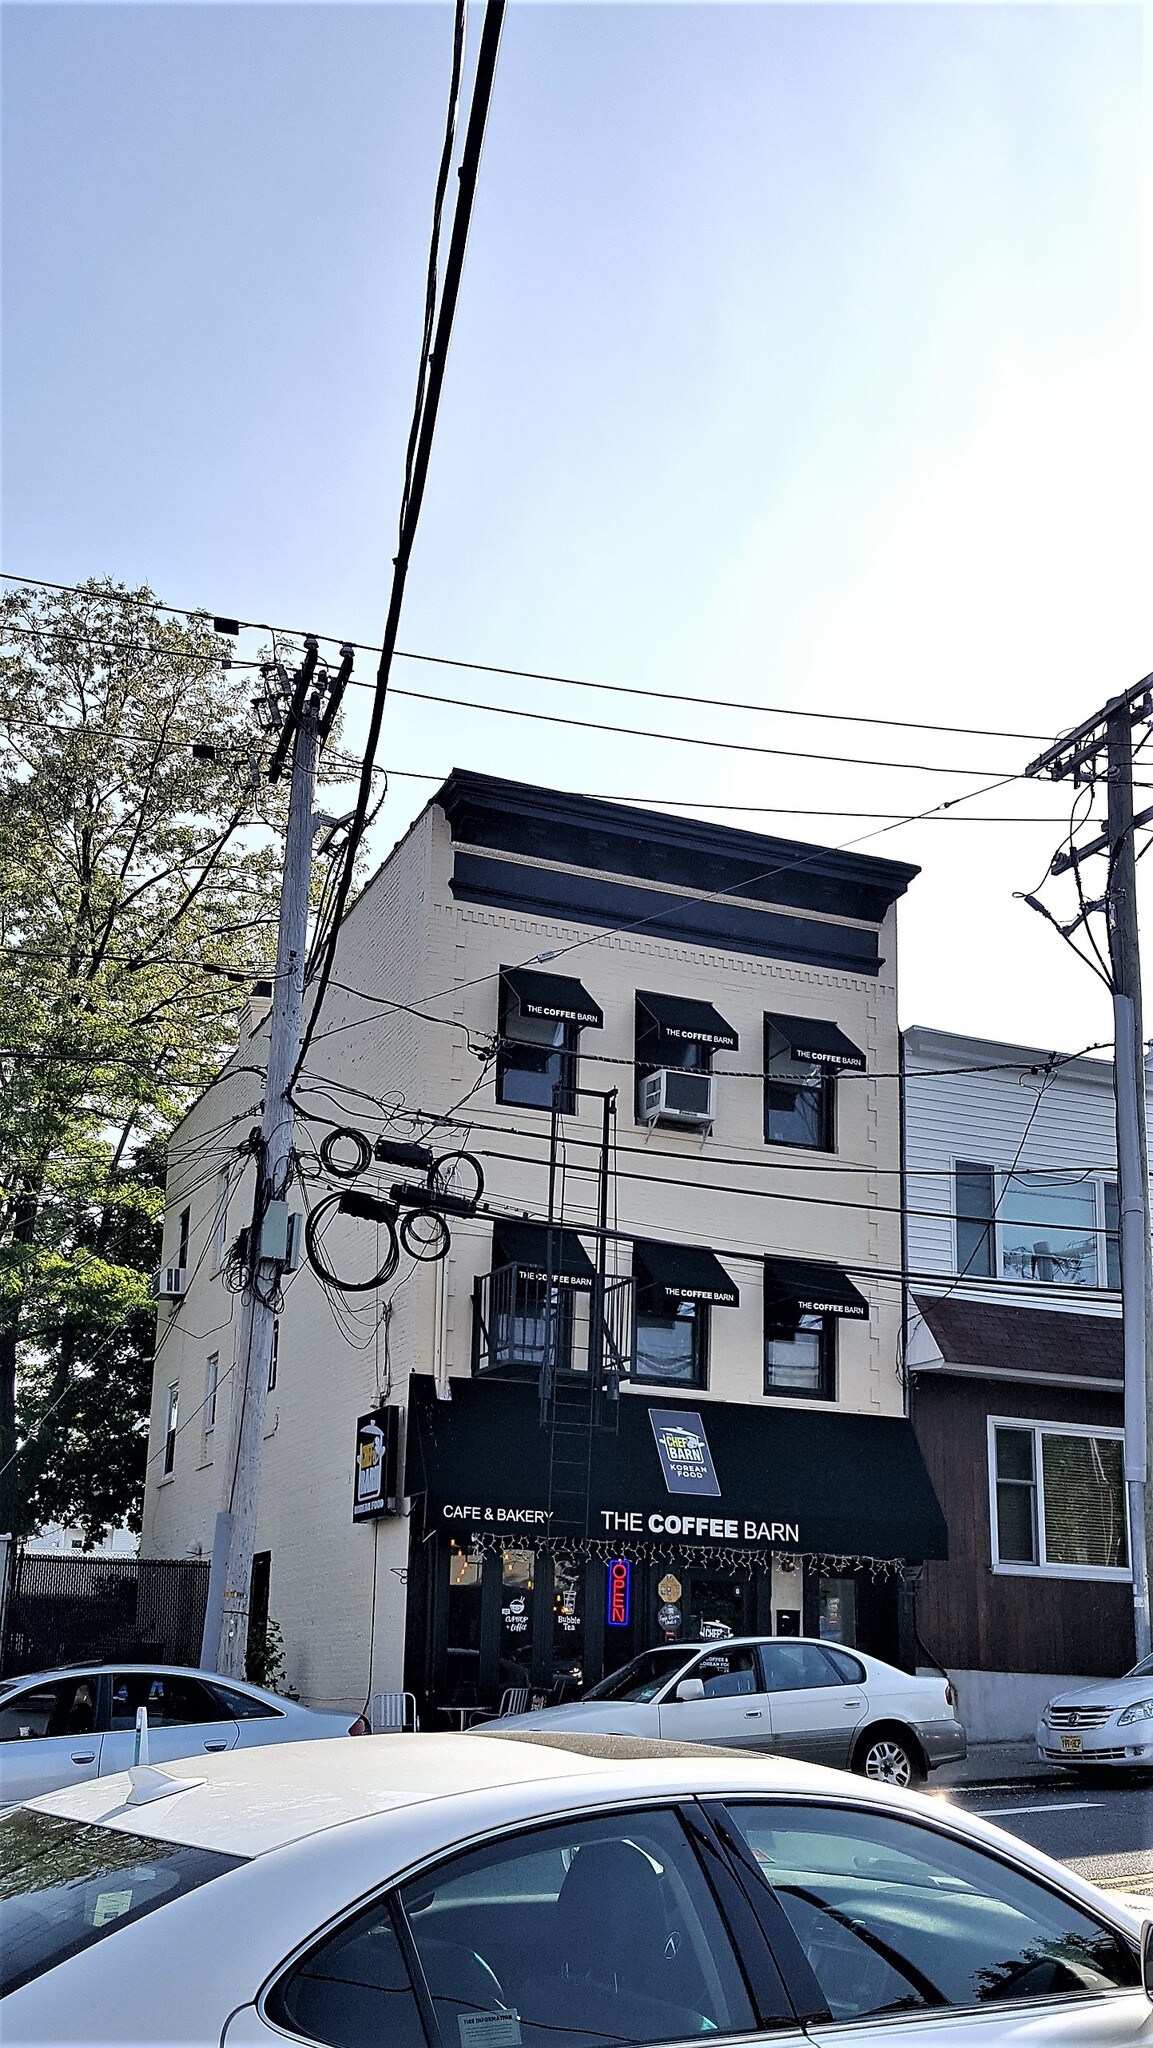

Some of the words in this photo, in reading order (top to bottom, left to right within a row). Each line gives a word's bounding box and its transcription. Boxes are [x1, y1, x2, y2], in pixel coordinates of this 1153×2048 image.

[527, 1004, 543, 1014] THE
[543, 1007, 576, 1020] COFFEE
[577, 1012, 598, 1023] BARN
[665, 1027, 681, 1037] THE
[681, 1030, 713, 1042] COFFEE
[713, 1035, 734, 1045] BARN
[796, 1049, 811, 1059] THE
[811, 1052, 841, 1064] COFFEE
[842, 1056, 862, 1066] BARN
[518, 1270, 535, 1280] THE
[535, 1273, 570, 1284] COFEE
[570, 1276, 592, 1286] BARN
[664, 1287, 680, 1296] THE
[680, 1289, 713, 1299] COFFEE
[713, 1292, 734, 1302] BARN
[798, 1300, 813, 1310] THE
[813, 1302, 844, 1313] COFFEE
[844, 1305, 864, 1315] BARN
[666, 1435, 687, 1448] CHEF
[668, 1447, 702, 1462] BARN
[669, 1463, 708, 1473] KOREAN
[677, 1470, 704, 1479] FOOD
[443, 1504, 481, 1520] CAFE
[484, 1507, 494, 1521] &
[497, 1508, 554, 1524] BAKERY
[600, 1510, 643, 1532] THE
[648, 1514, 739, 1539] COFFEE
[744, 1521, 800, 1543] BARN
[612, 1564, 627, 1623] OPEN
[557, 1615, 581, 1625] Bubble
[562, 1622, 576, 1631] Tea
[475, 2014, 513, 2024] INFORMATION
